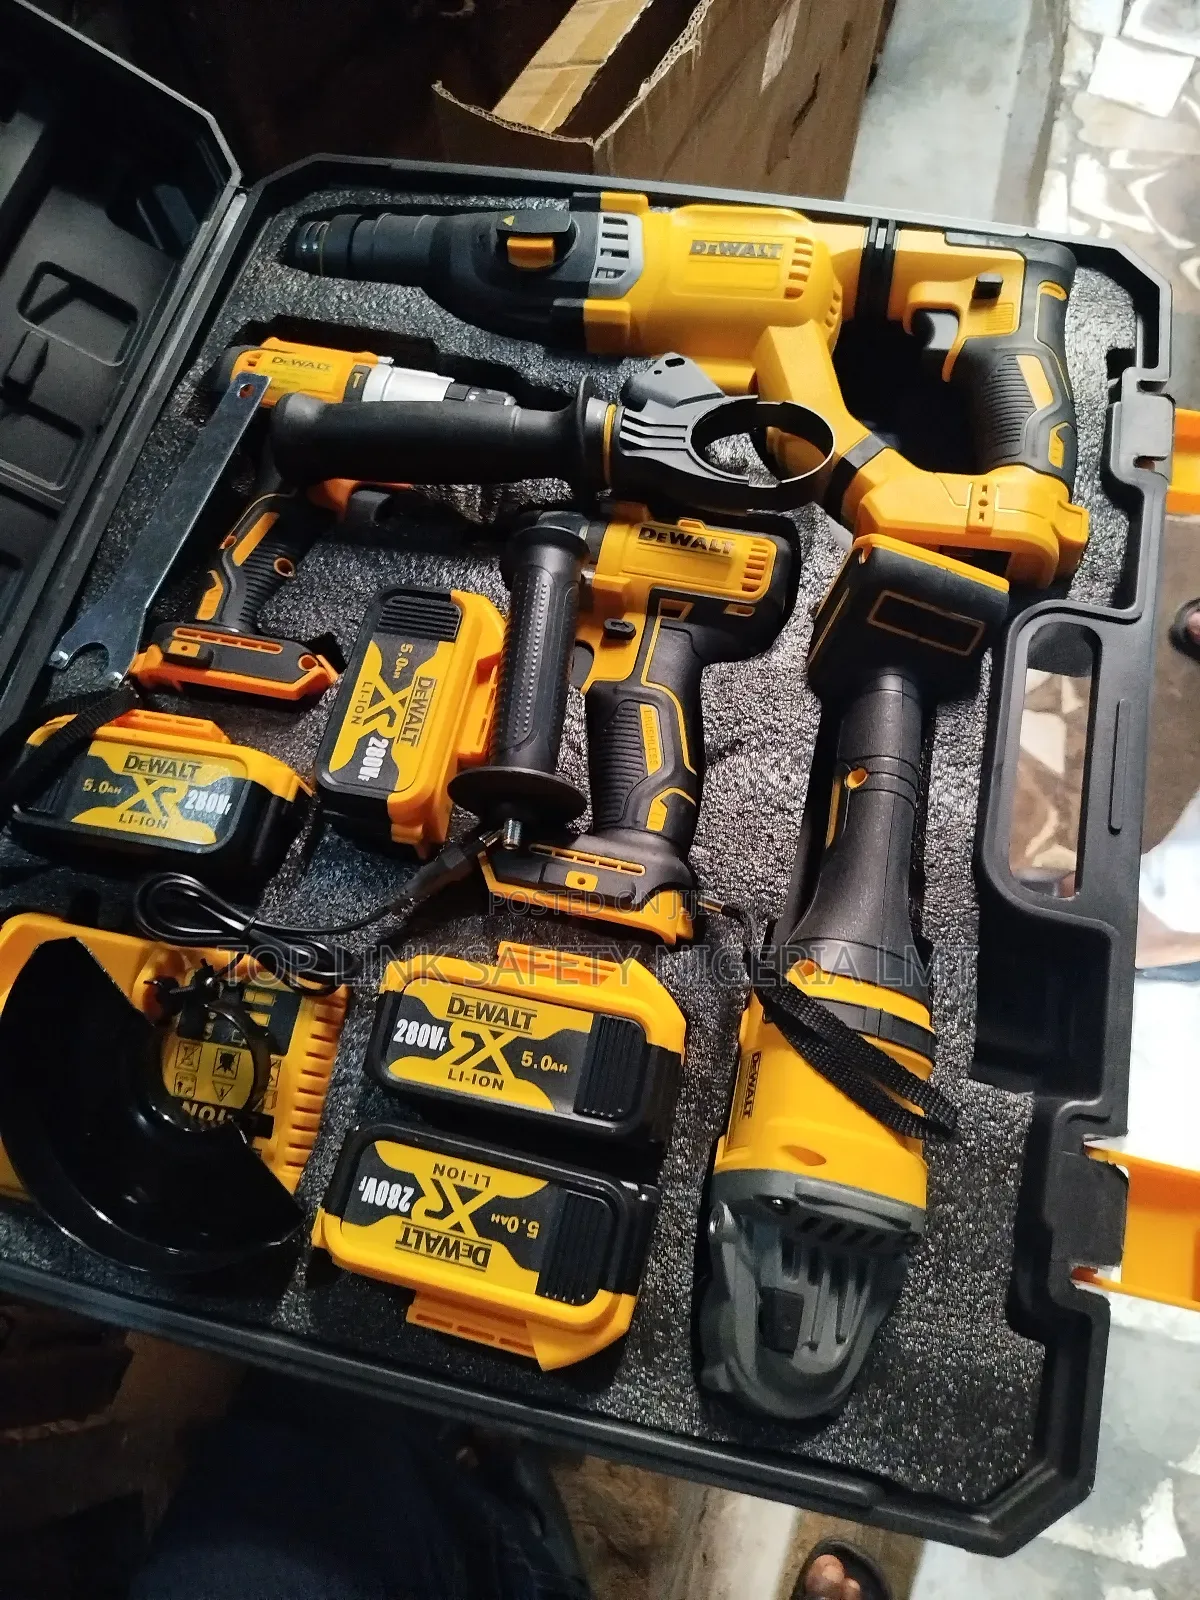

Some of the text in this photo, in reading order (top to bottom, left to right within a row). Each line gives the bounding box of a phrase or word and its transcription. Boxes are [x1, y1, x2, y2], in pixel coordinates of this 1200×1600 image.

[350, 681, 373, 725] LI-ION
[118, 813, 169, 830] LI-ION
[447, 1068, 505, 1091] LI-ION
[432, 1163, 492, 1188] LI-ION
